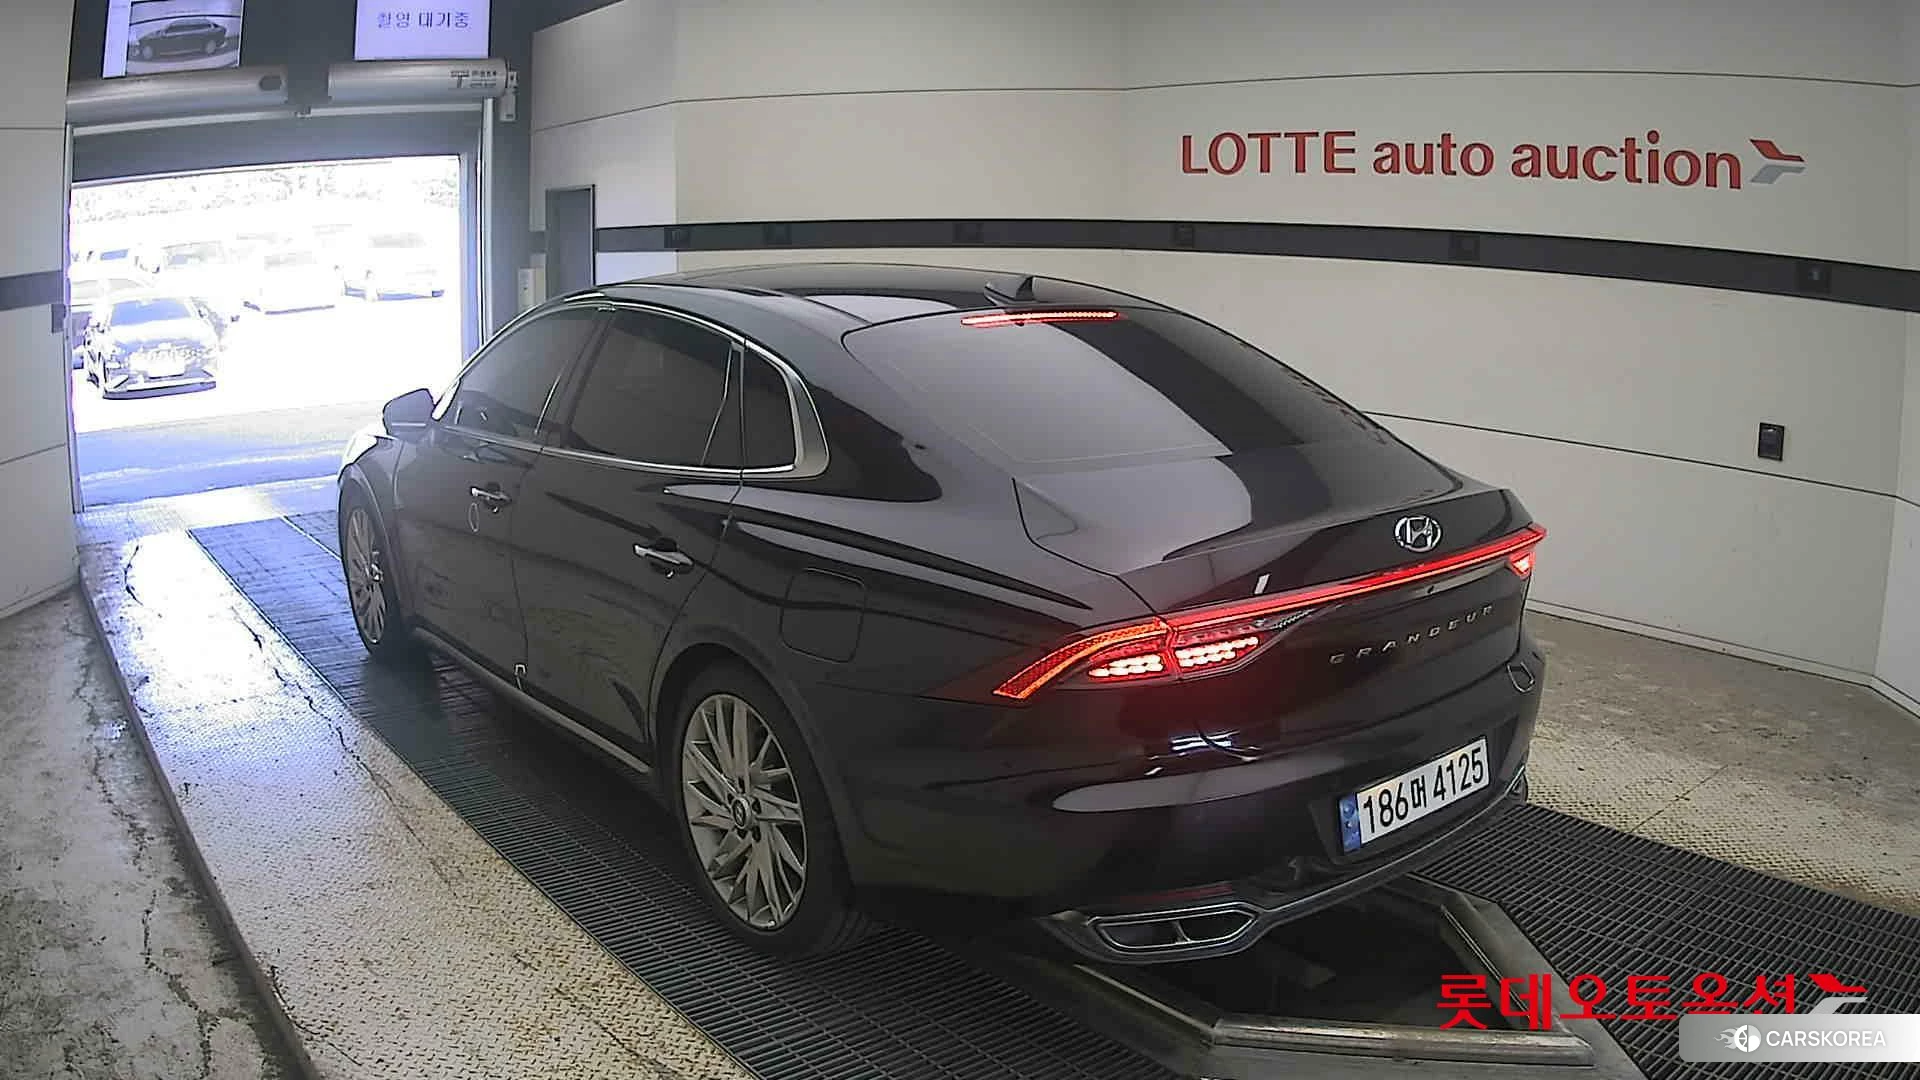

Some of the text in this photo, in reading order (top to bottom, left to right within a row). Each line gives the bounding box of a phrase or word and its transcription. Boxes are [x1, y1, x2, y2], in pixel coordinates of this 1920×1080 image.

[418, 11, 469, 29] 대기중
[1181, 129, 1742, 190] LOTTE auto auction
[1328, 605, 1493, 665] GRANDEUR
[1432, 747, 1484, 801] 4125
